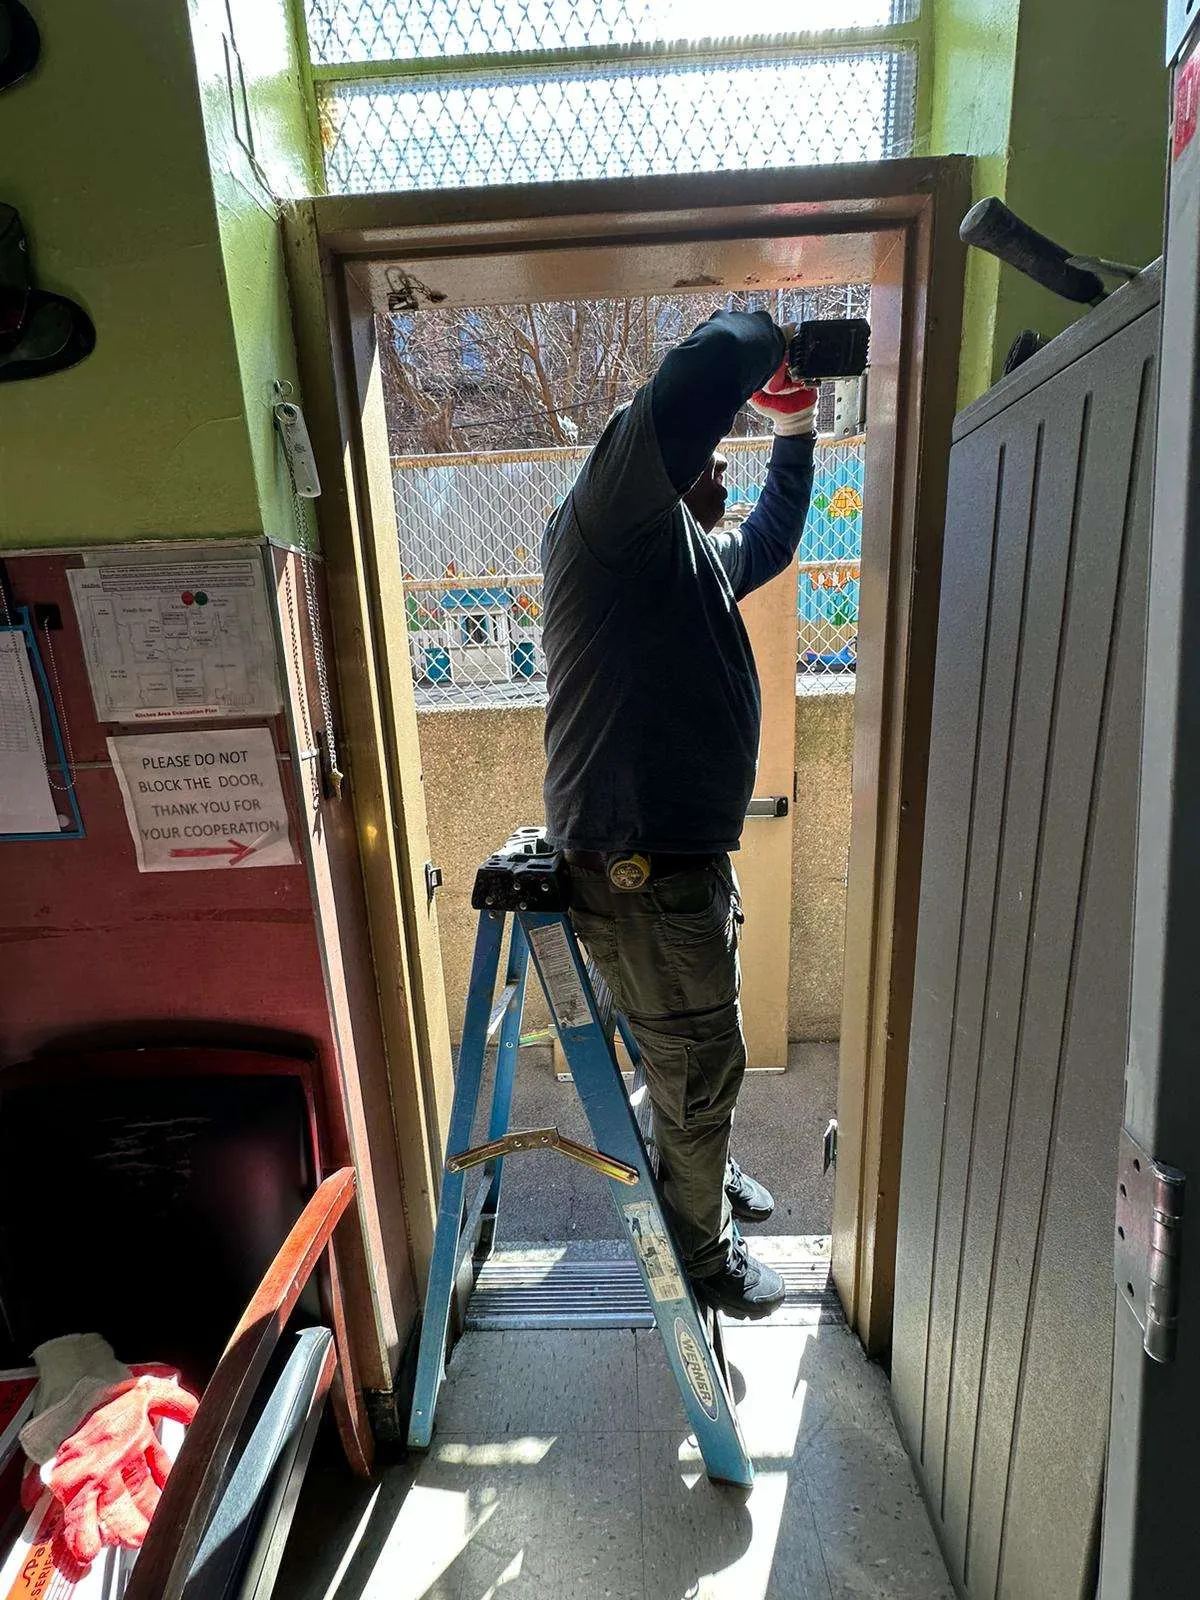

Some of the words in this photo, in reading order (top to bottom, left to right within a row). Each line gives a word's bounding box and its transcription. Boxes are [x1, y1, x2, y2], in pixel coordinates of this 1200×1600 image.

[142, 754, 191, 770] PLEASE
[194, 752, 215, 766] DO
[219, 750, 248, 764] NOT
[138, 779, 182, 793] BLOCK
[183, 777, 212, 790] THE
[218, 773, 264, 788] DOOR,
[151, 802, 199, 817] THANK
[200, 800, 231, 813] YOU
[234, 799, 261, 812] FOR
[141, 826, 183, 841] YOUR
[184, 820, 280, 837] COOPERATION
[682, 1338, 711, 1402] WERNER
